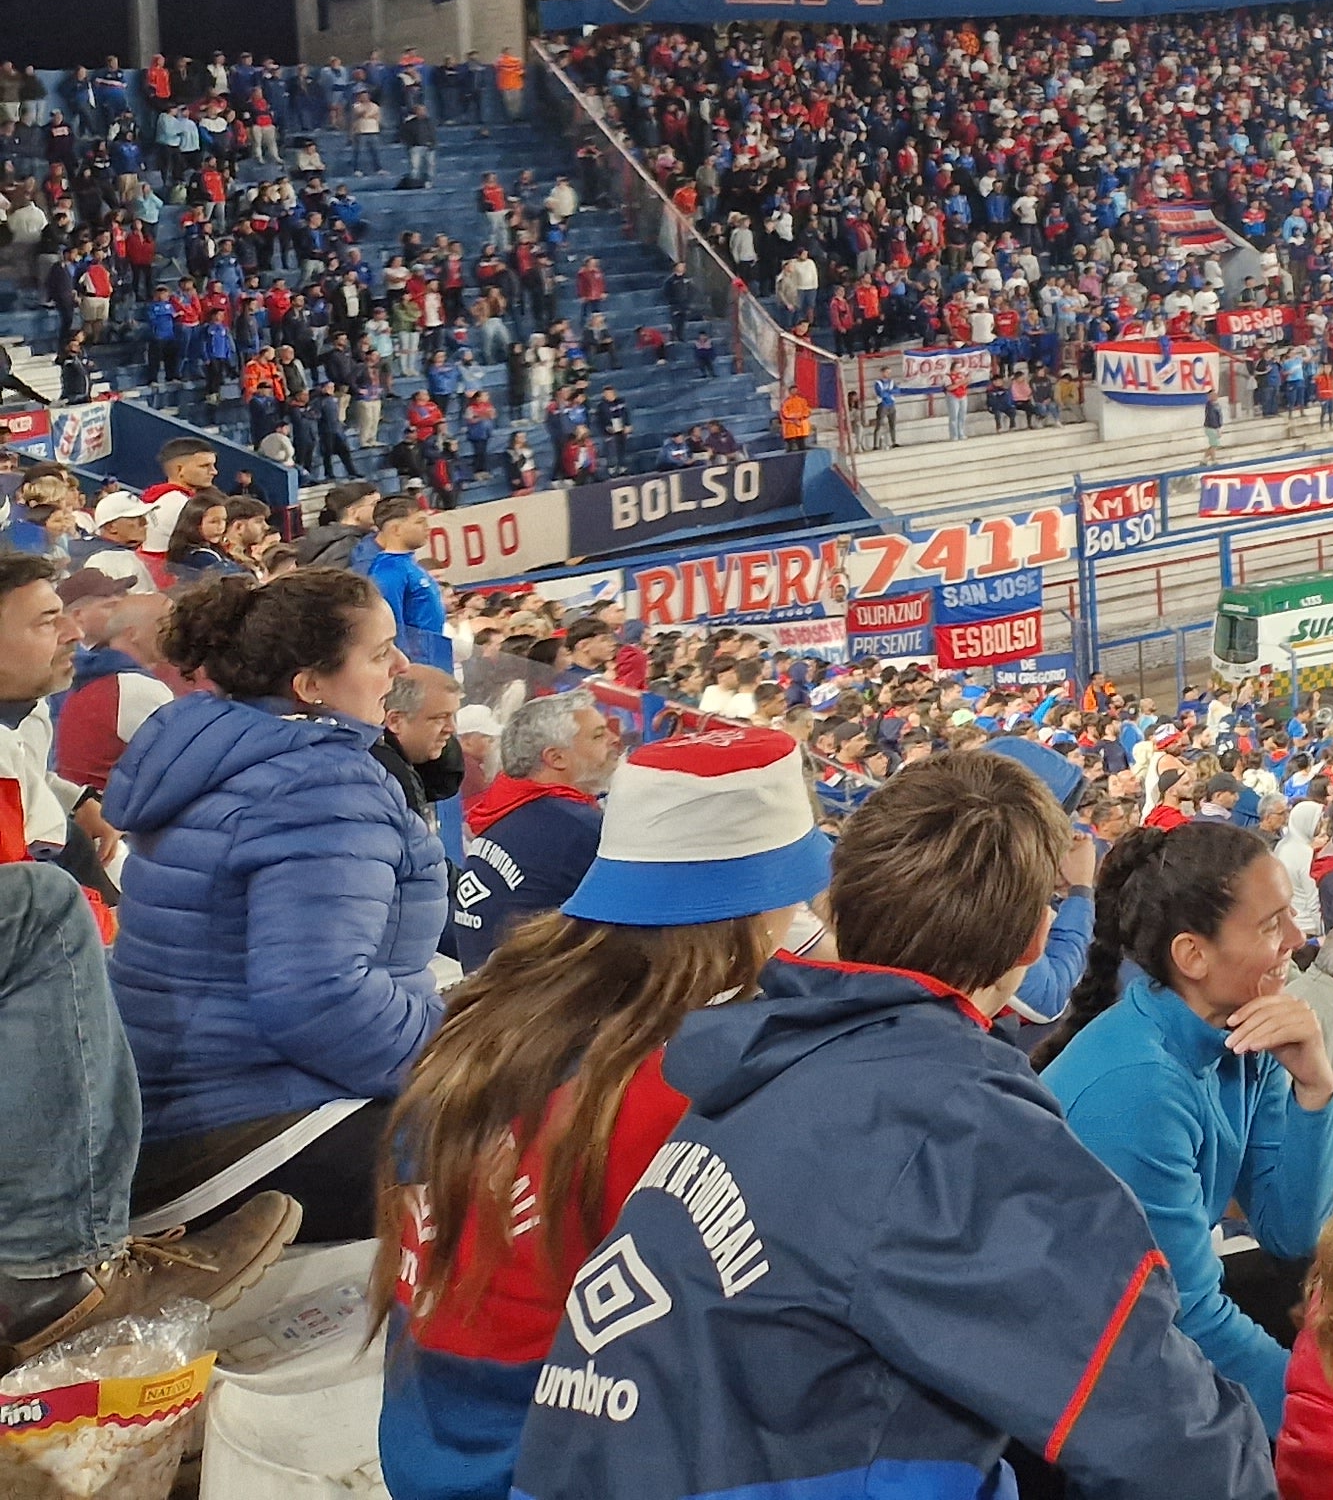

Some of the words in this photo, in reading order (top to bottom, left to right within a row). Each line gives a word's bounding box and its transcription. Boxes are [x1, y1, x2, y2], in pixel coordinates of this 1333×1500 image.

[904, 356, 947, 379] LOS
[611, 461, 761, 531] BOLSO
[1124, 480, 1155, 514] 16
[855, 506, 1070, 598] 7411
[942, 582, 988, 609] SAN
[988, 570, 1039, 604] JOSE
[856, 599, 923, 626] DURAZNO
[852, 630, 923, 657] PRESENTE
[995, 672, 1017, 685] SAN
[1018, 667, 1067, 686] GREGORIO
[1020, 657, 1037, 672] DE
[683, 1154, 770, 1298] FOOTBALL
[534, 1359, 640, 1422] umbro
